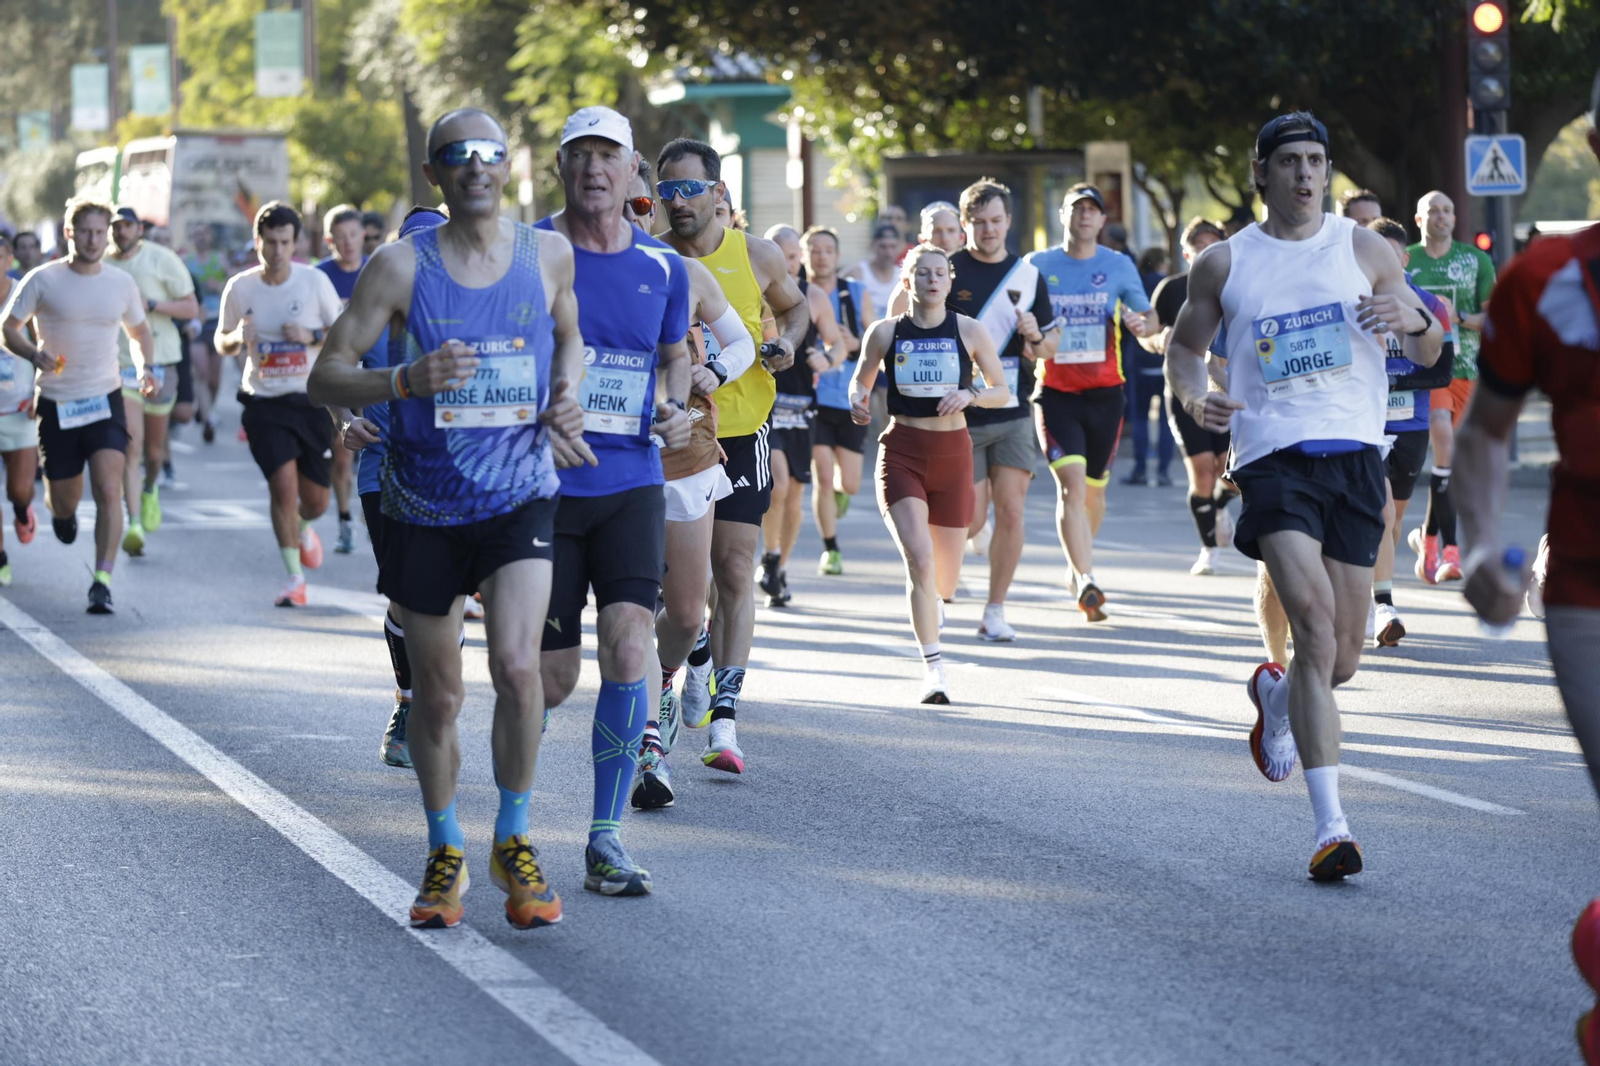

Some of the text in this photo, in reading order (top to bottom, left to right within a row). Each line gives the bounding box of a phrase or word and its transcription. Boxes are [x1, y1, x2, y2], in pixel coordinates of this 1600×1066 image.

[1284, 309, 1333, 330] ZURICH
[470, 340, 522, 354] ZURIC
[918, 342, 952, 350] ZURICH
[1290, 338, 1316, 352] 5873
[601, 353, 644, 368] ZURICH
[918, 359, 937, 367] 7460
[1281, 351, 1334, 376] JORGE
[599, 377, 623, 390] 5722
[913, 371, 942, 382] LULU
[436, 383, 536, 404] JOSÉ ÁNGEL
[587, 393, 628, 412] HENK
